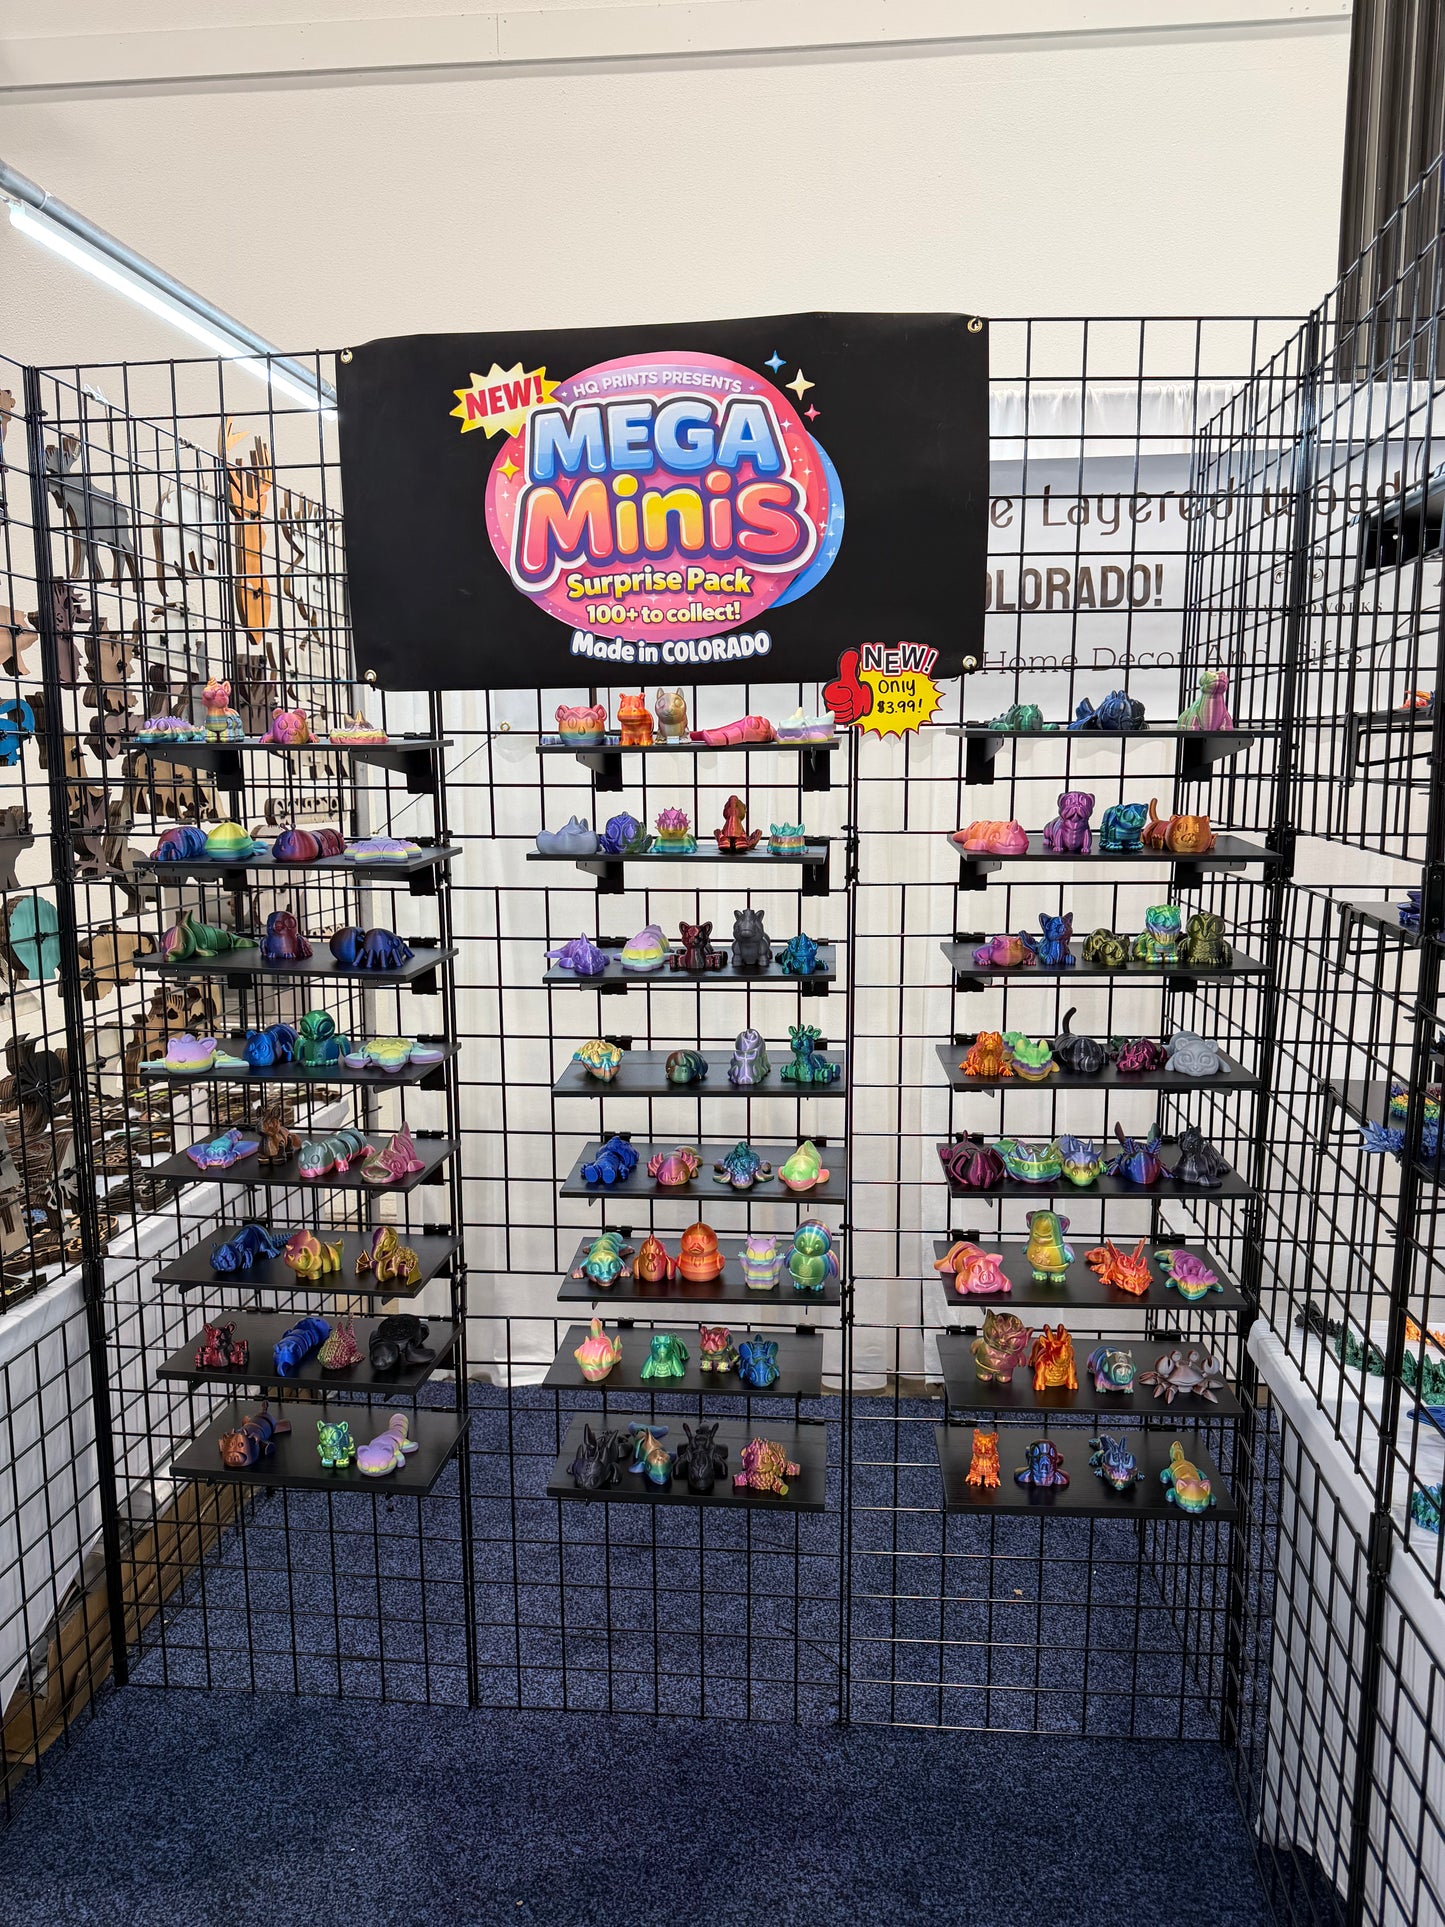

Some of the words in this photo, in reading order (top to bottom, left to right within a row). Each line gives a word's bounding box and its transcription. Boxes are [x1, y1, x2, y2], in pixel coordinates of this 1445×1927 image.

[465, 375, 544, 421] NEW!
[573, 382, 600, 398] HQ
[603, 371, 658, 390] PRINTS
[662, 371, 742, 393] PRESENTS
[533, 400, 779, 480] MEGA
[1043, 476, 1235, 535] Layered
[520, 470, 802, 575] Minis
[567, 565, 682, 598] Surprise
[688, 567, 752, 593] Pack
[587, 604, 638, 624] 100+
[642, 604, 663, 623] to
[666, 602, 740, 623] collect!
[572, 631, 635, 662] Made
[639, 641, 658, 662] in
[663, 632, 770, 663] COLORADO
[863, 643, 937, 675] NEW!
[982, 650, 1078, 674] Home
[878, 680, 915, 696] Only
[877, 699, 922, 714] $3.99!
